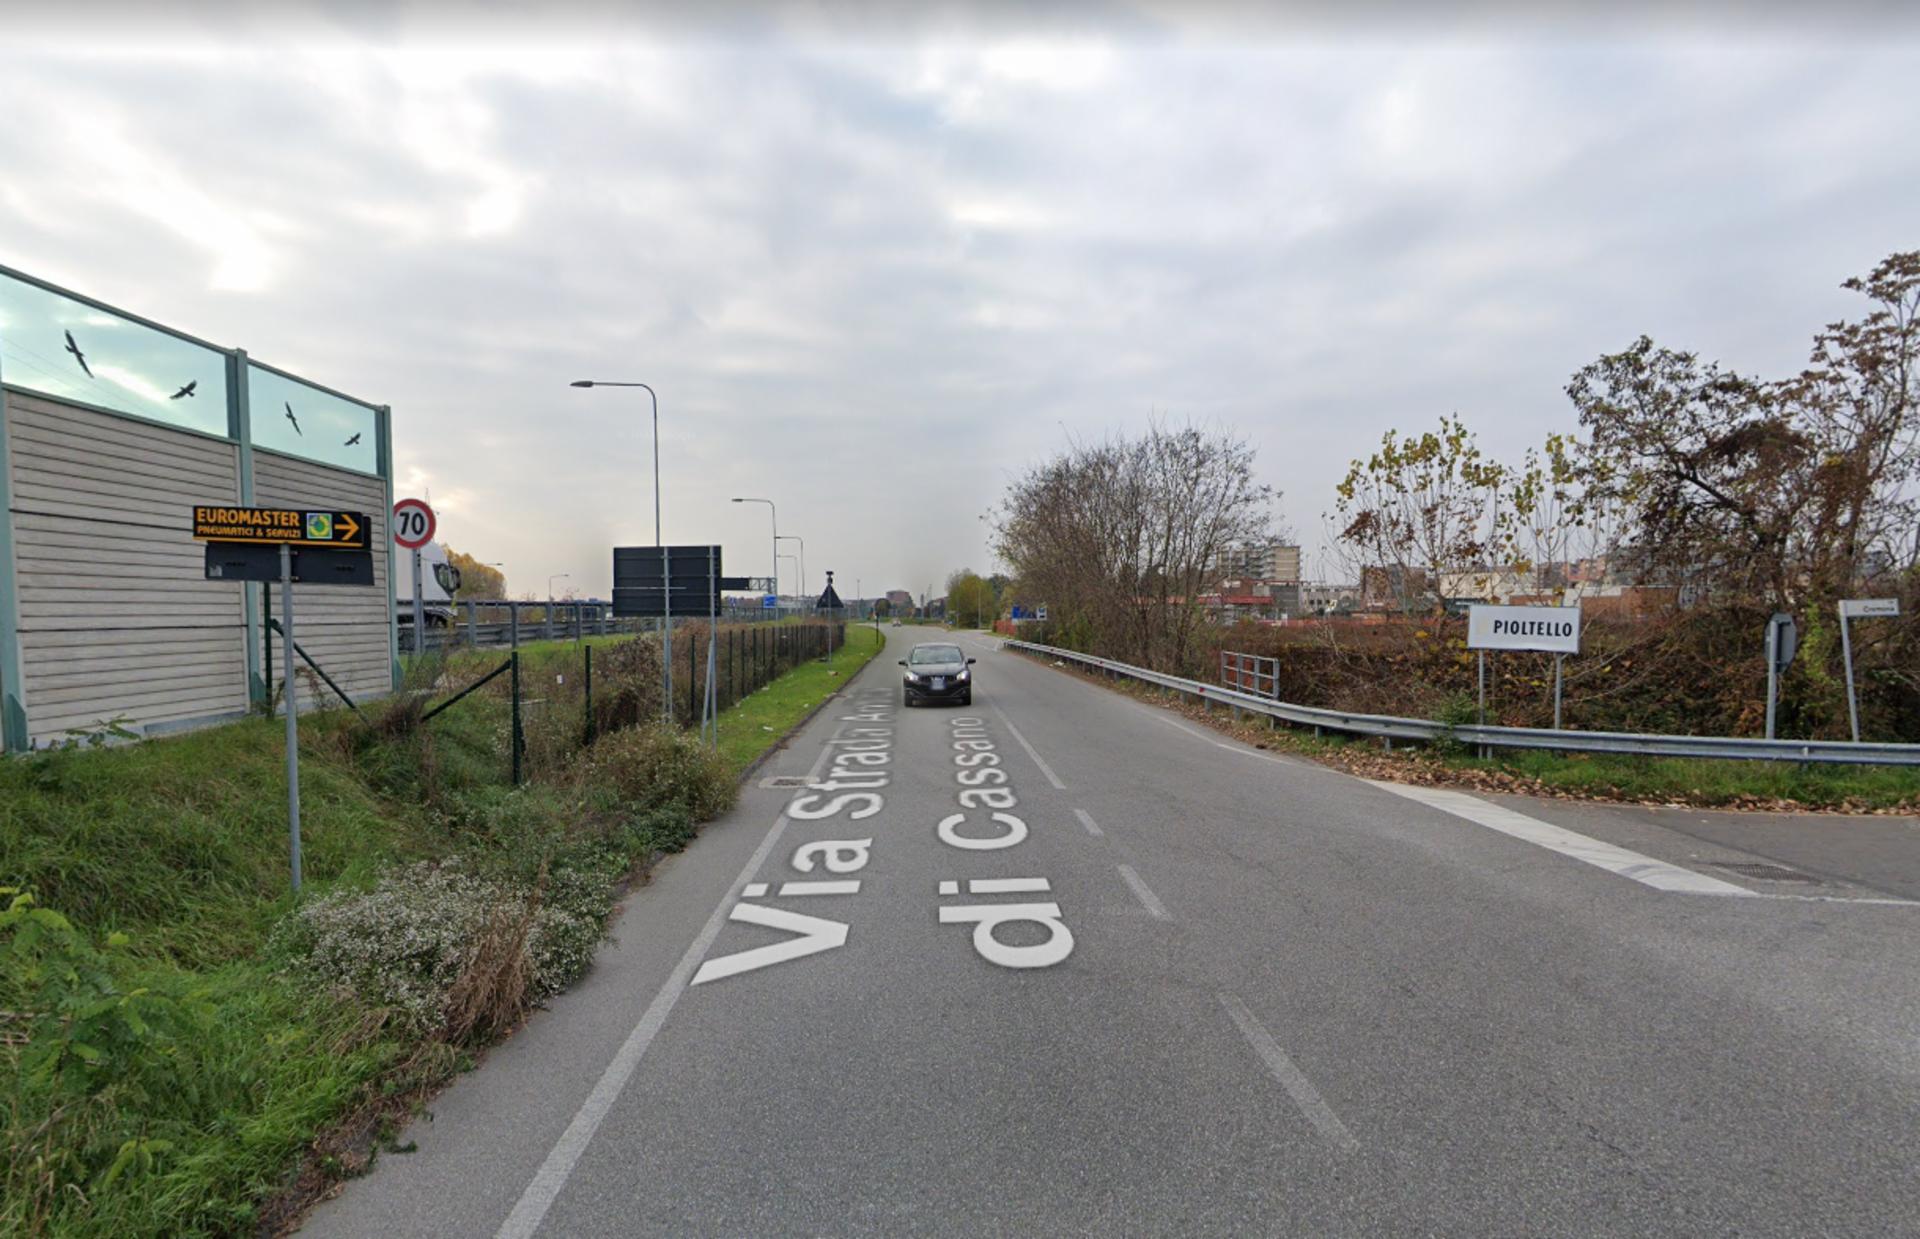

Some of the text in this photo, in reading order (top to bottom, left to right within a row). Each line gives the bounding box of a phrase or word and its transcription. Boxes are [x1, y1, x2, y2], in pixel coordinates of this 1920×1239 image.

[196, 508, 300, 527] EUROMASTER
[400, 512, 425, 536] 70
[196, 526, 253, 536] PNEUMATICI
[256, 527, 264, 537] &
[1493, 619, 1572, 637] PIOLTELLO
